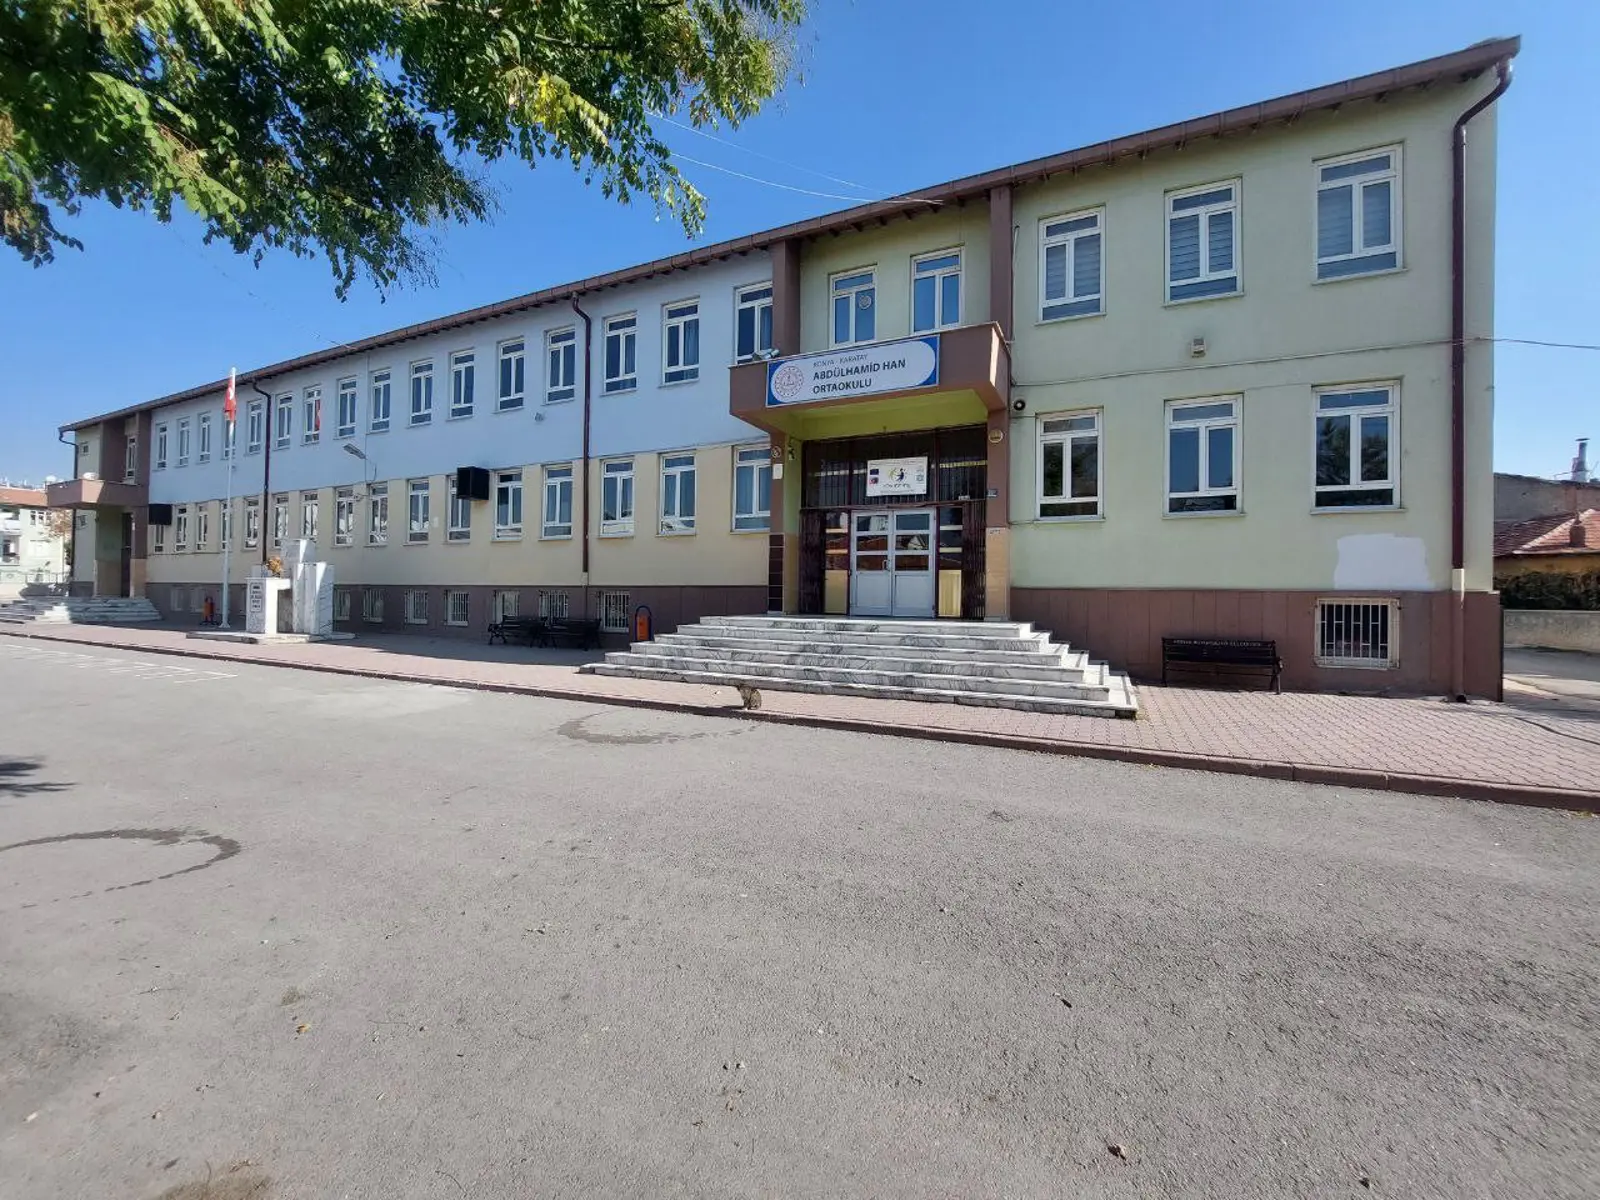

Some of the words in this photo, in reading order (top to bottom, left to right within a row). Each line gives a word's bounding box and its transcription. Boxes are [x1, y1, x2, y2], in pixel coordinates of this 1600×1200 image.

[839, 354, 868, 364] KARATAY
[813, 363, 880, 380] ABDÜLHAMİD
[882, 359, 906, 371] HAN
[813, 378, 872, 394] ORTAOKULU
